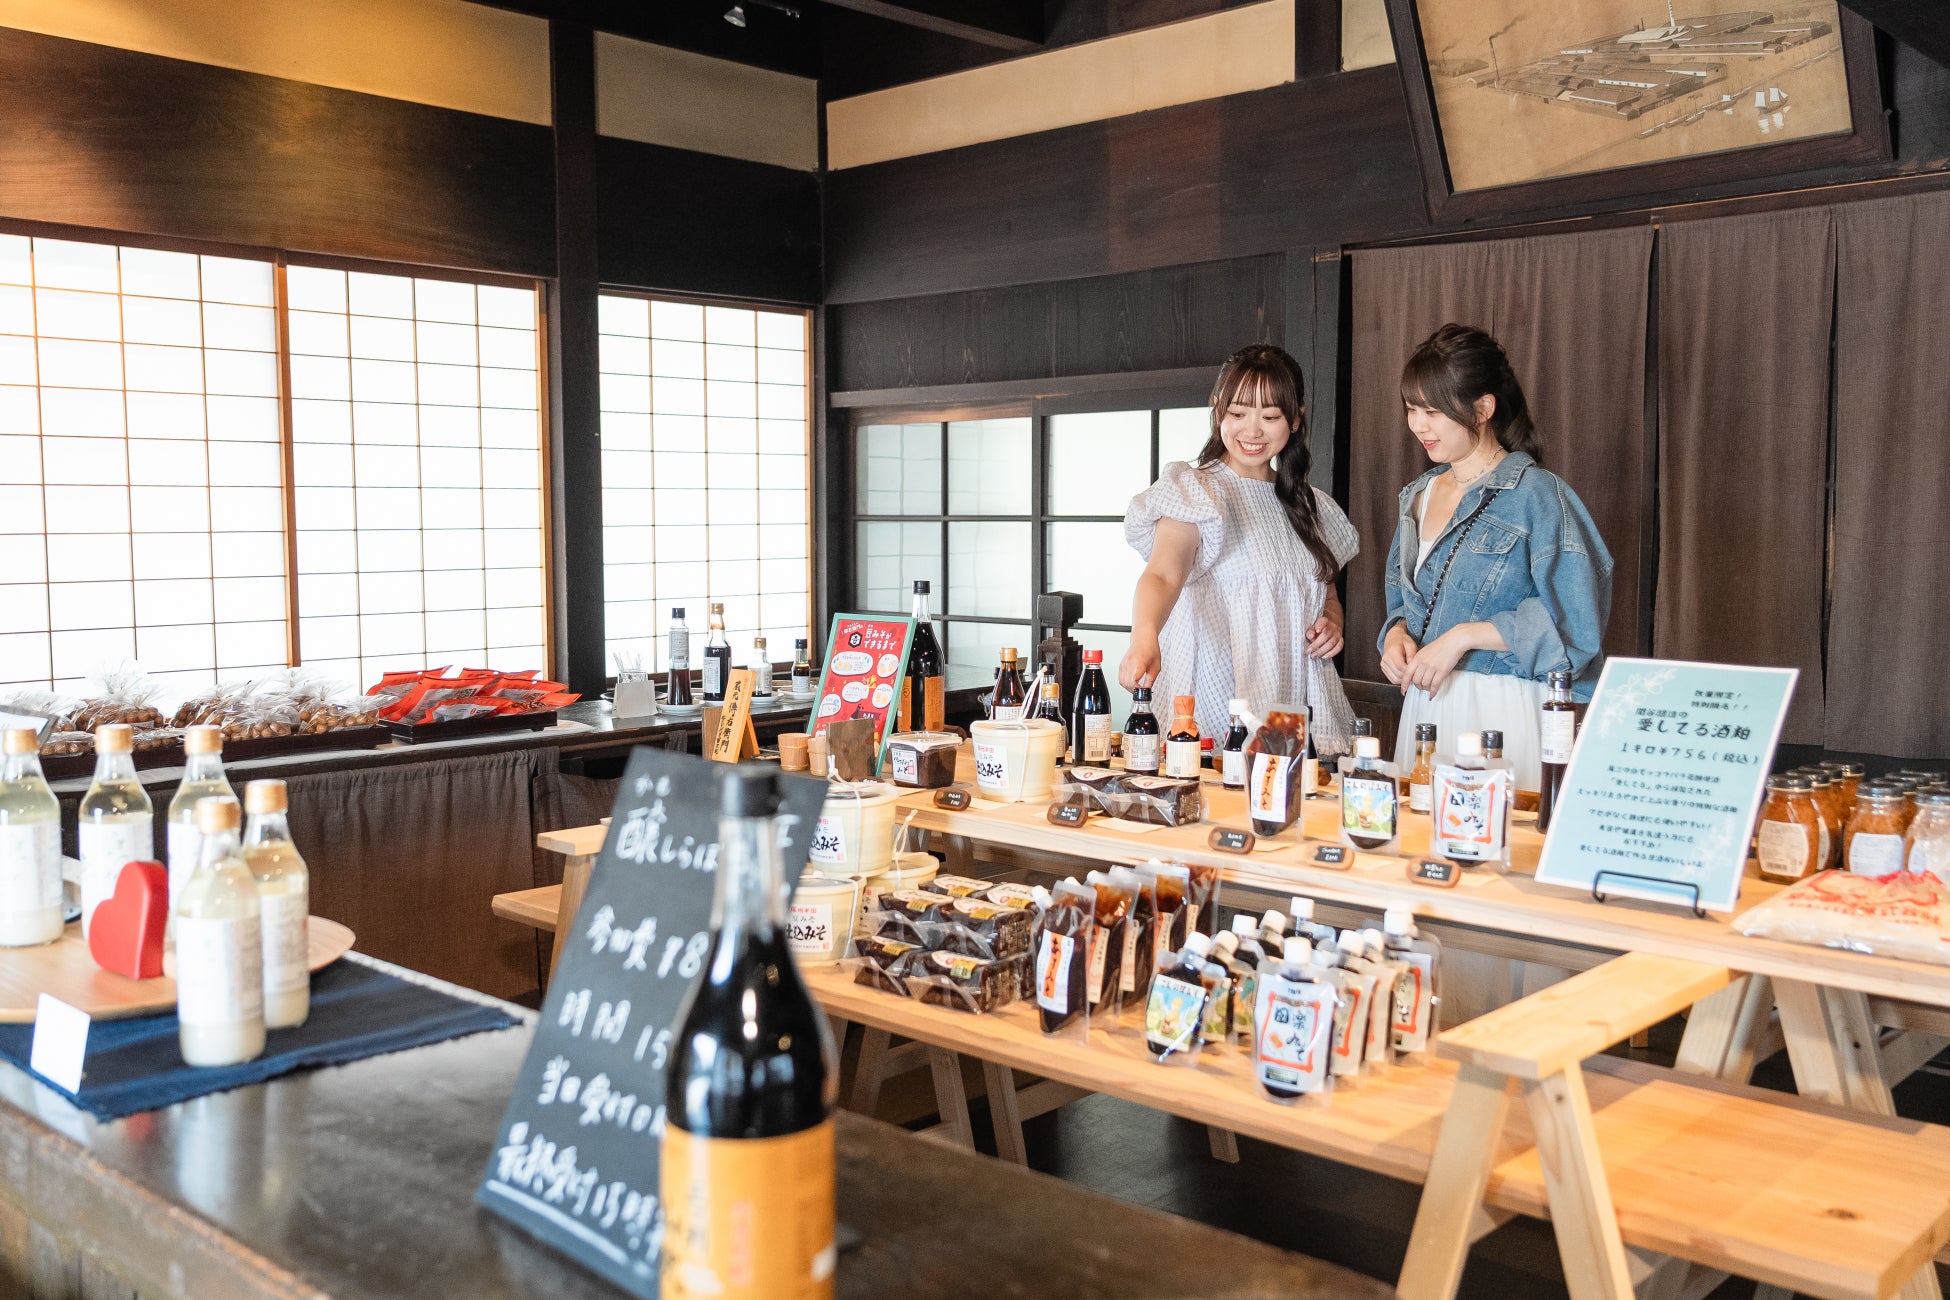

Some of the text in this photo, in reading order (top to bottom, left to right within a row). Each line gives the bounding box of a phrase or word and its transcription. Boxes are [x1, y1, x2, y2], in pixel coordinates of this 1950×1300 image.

[864, 639, 896, 650] できるまで
[1637, 717, 1751, 740] 愛してる酒粕
